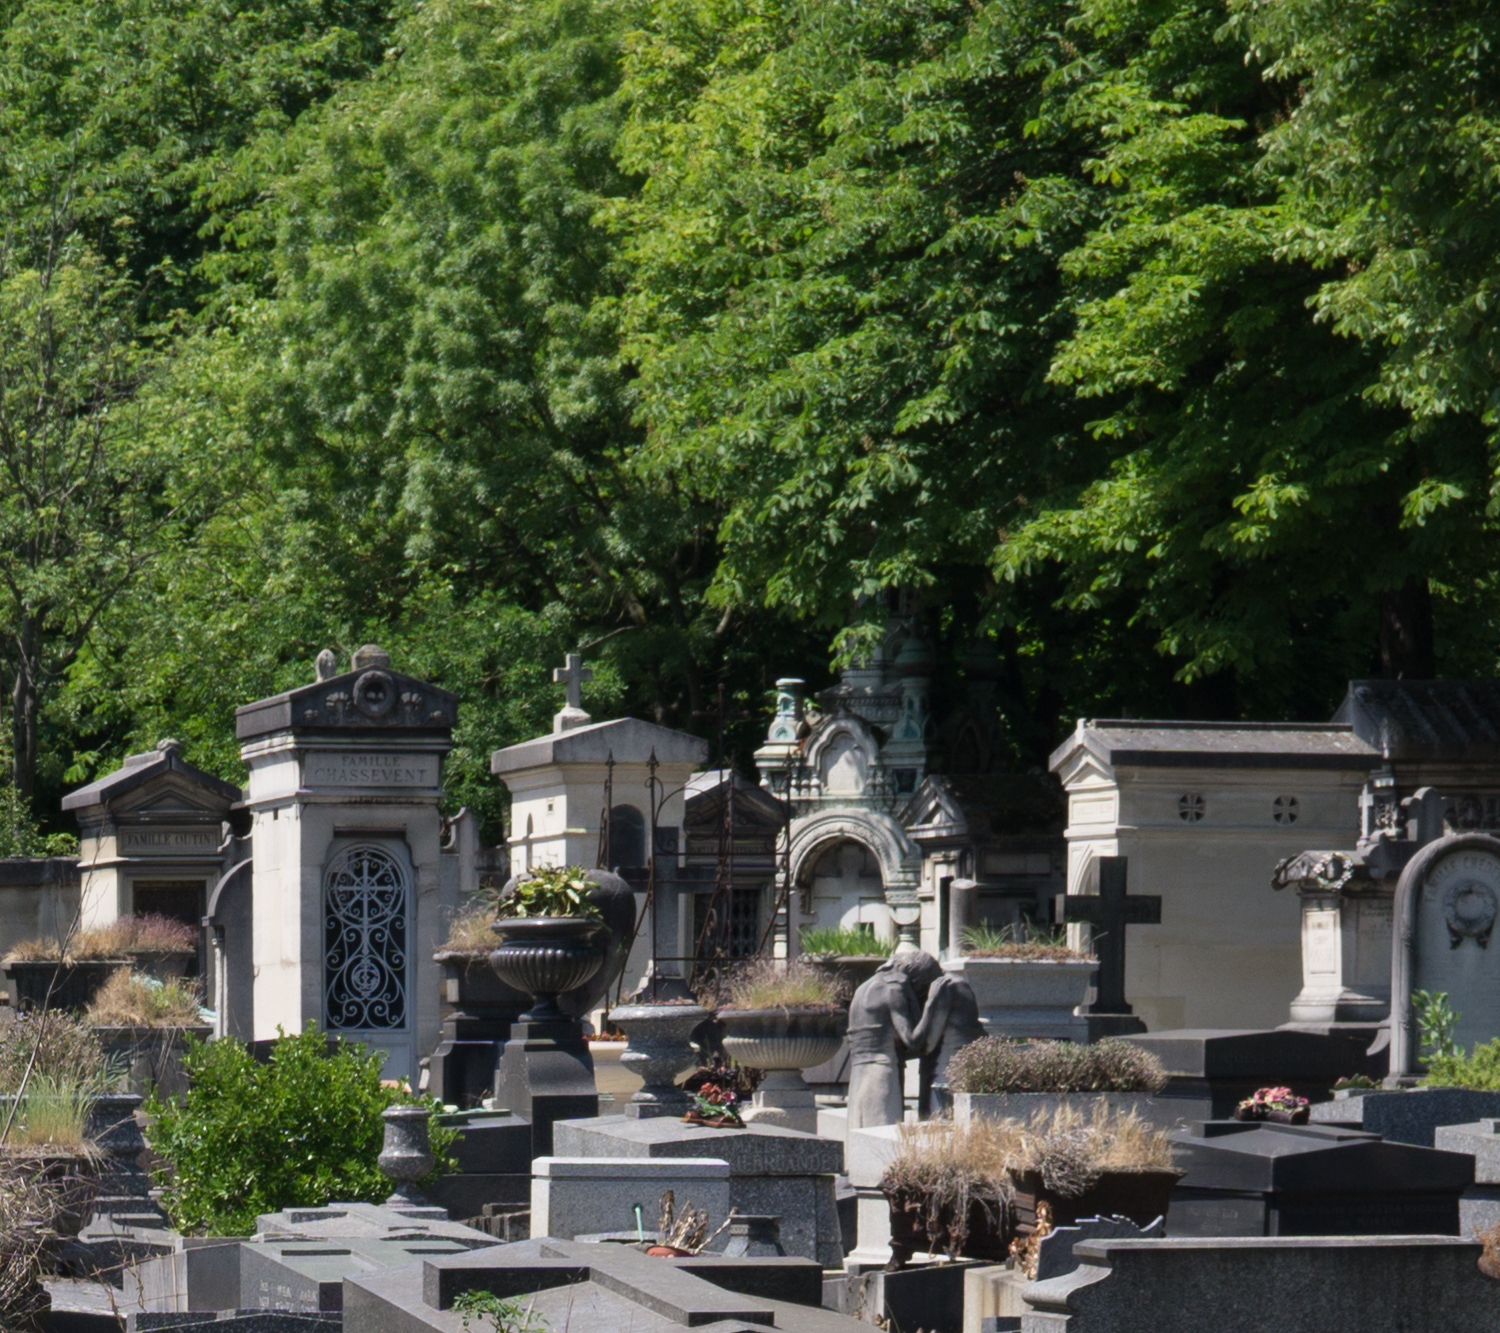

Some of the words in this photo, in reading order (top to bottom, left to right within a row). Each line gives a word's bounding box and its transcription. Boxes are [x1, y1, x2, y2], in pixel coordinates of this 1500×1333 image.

[342, 755, 400, 767] FAMILLE
[314, 768, 428, 783] CHASSEVENT
[128, 833, 170, 846] FAMILLE
[175, 833, 208, 845] OUTIN
